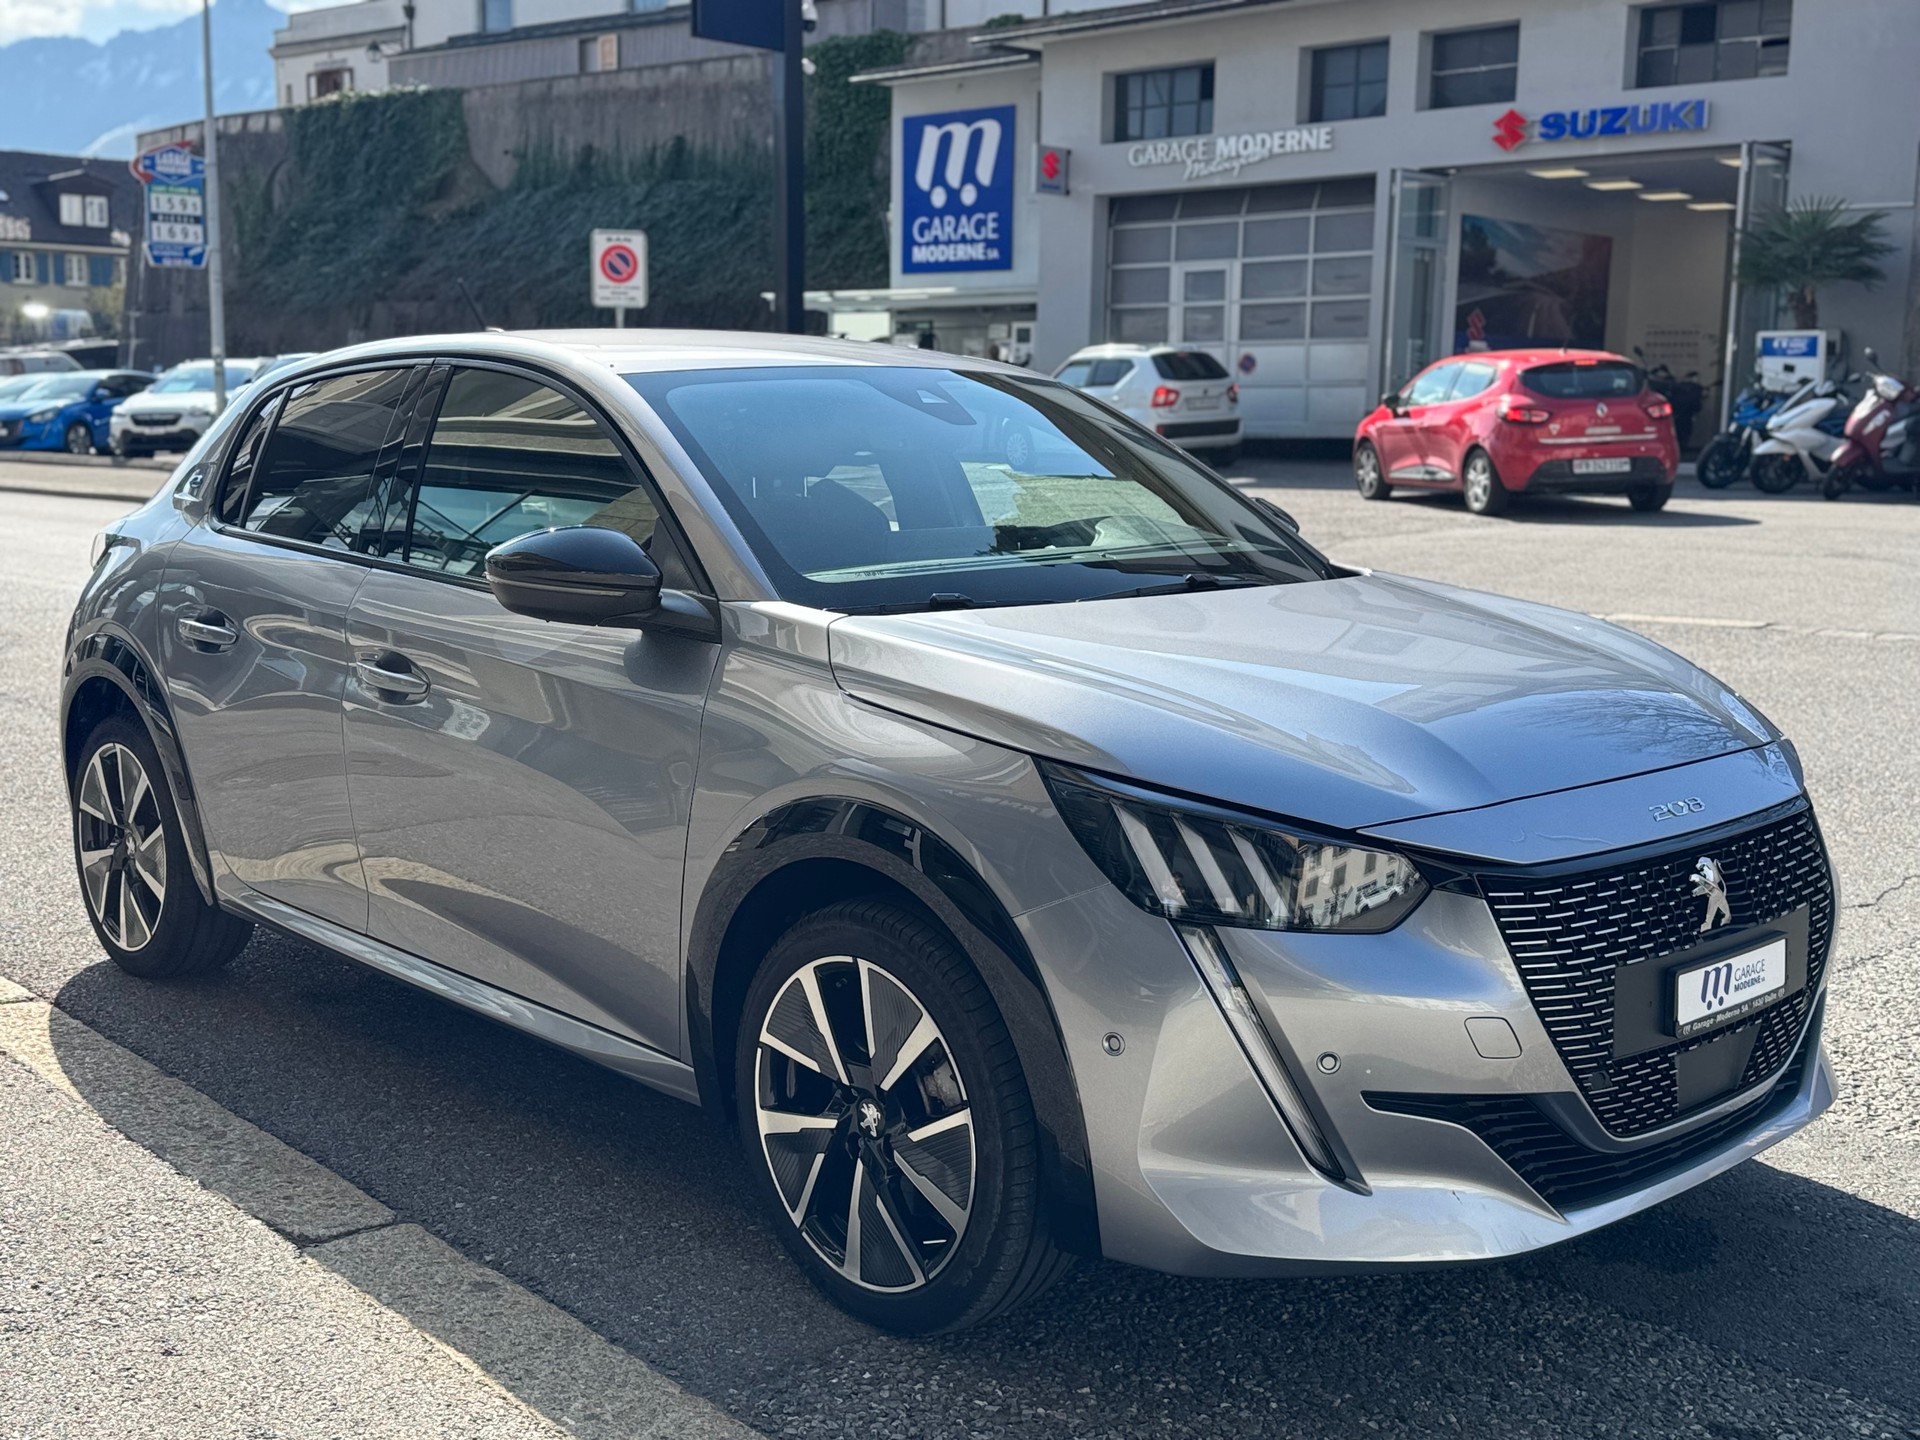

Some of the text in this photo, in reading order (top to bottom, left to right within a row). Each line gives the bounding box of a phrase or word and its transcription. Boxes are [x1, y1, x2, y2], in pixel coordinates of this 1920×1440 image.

[1538, 99, 1710, 141] SUZUKI
[1128, 138, 1209, 167] GARAGE
[1215, 126, 1333, 159] MODERNE
[912, 212, 999, 244] GARAGE
[911, 242, 986, 263] MODERNE
[1648, 796, 1706, 822] 208
[1734, 959, 1766, 982] GARAGE
[1734, 975, 1761, 992] MODERNE
[1692, 1018, 1714, 1031] Garage
[1715, 1007, 1740, 1022] Moderne
[1741, 1003, 1749, 1013] SA
